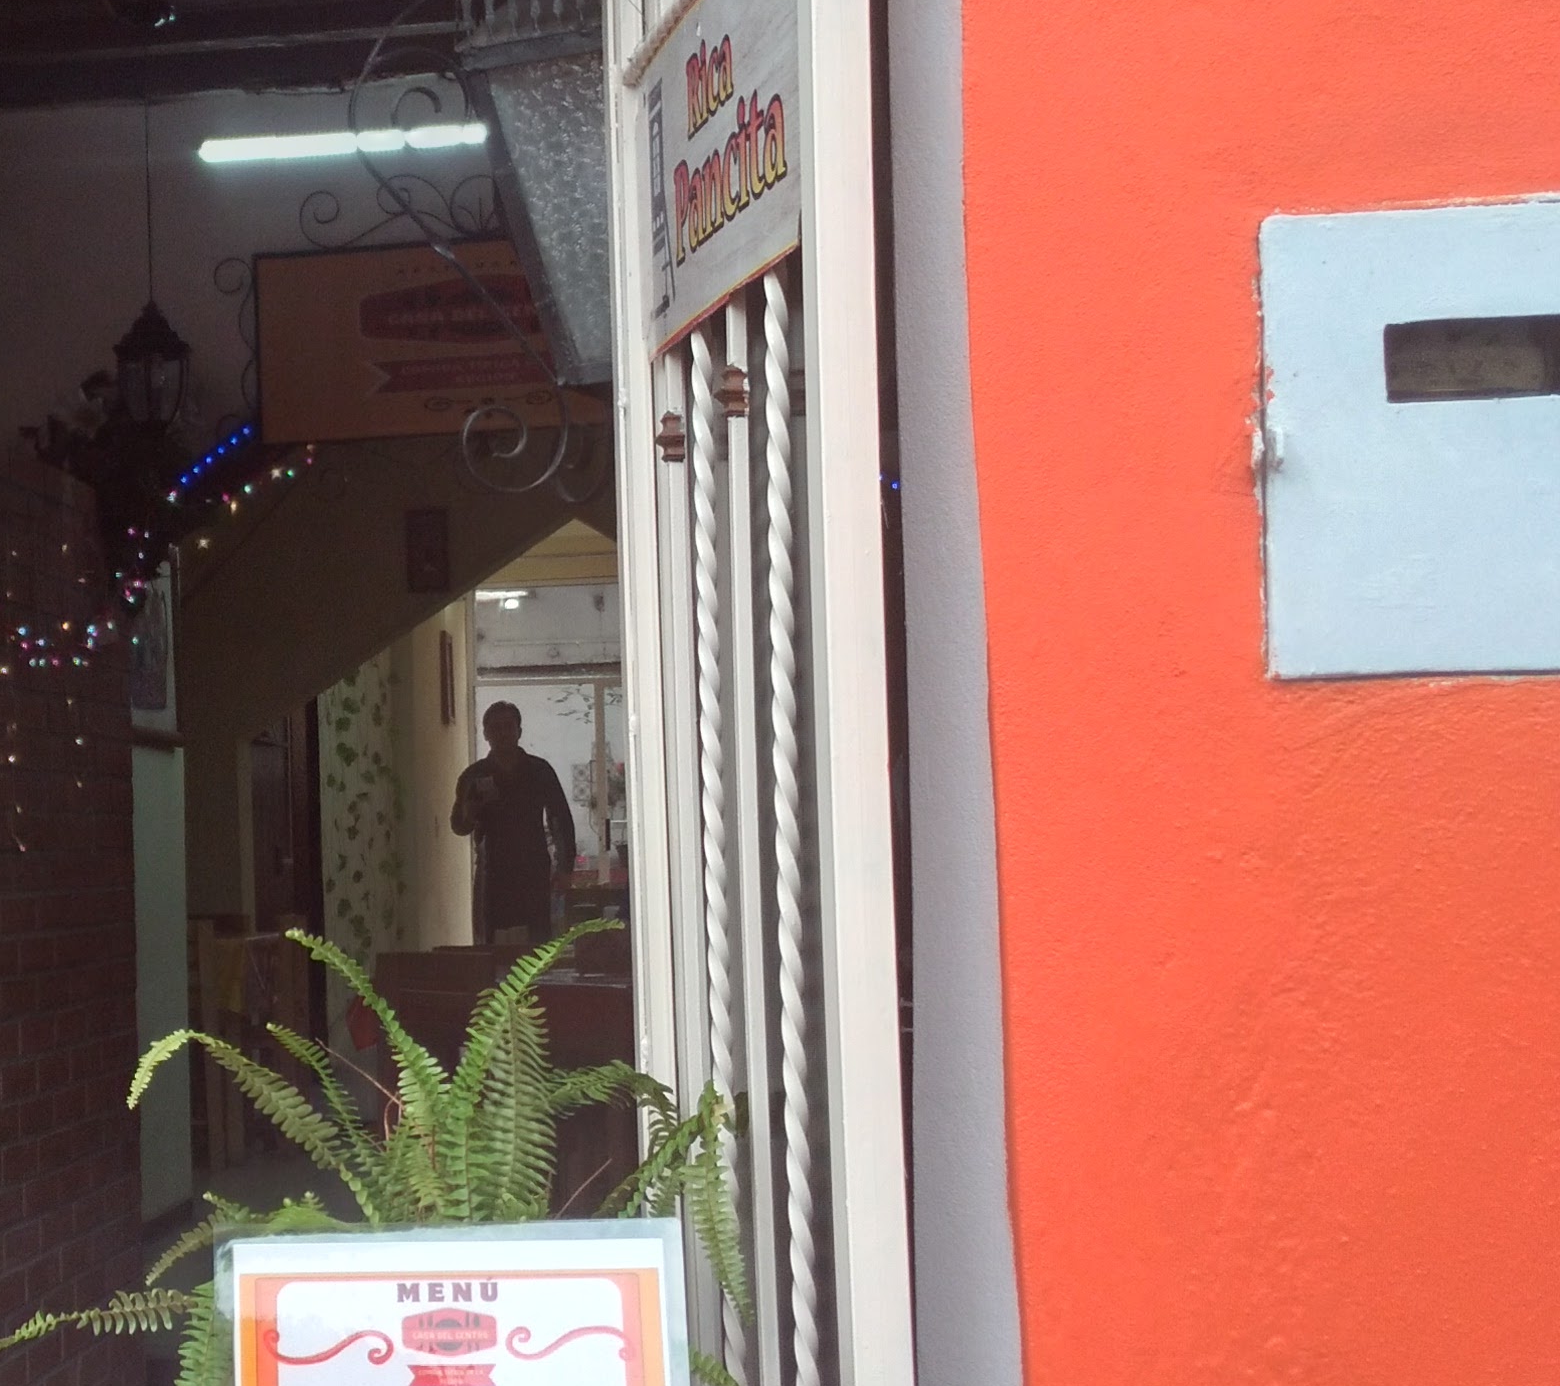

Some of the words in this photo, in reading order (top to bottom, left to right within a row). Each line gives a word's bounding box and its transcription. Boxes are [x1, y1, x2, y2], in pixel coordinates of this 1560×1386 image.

[686, 34, 734, 141] Rica
[674, 88, 787, 267] Pancita
[396, 1277, 499, 1303] MENÚ
